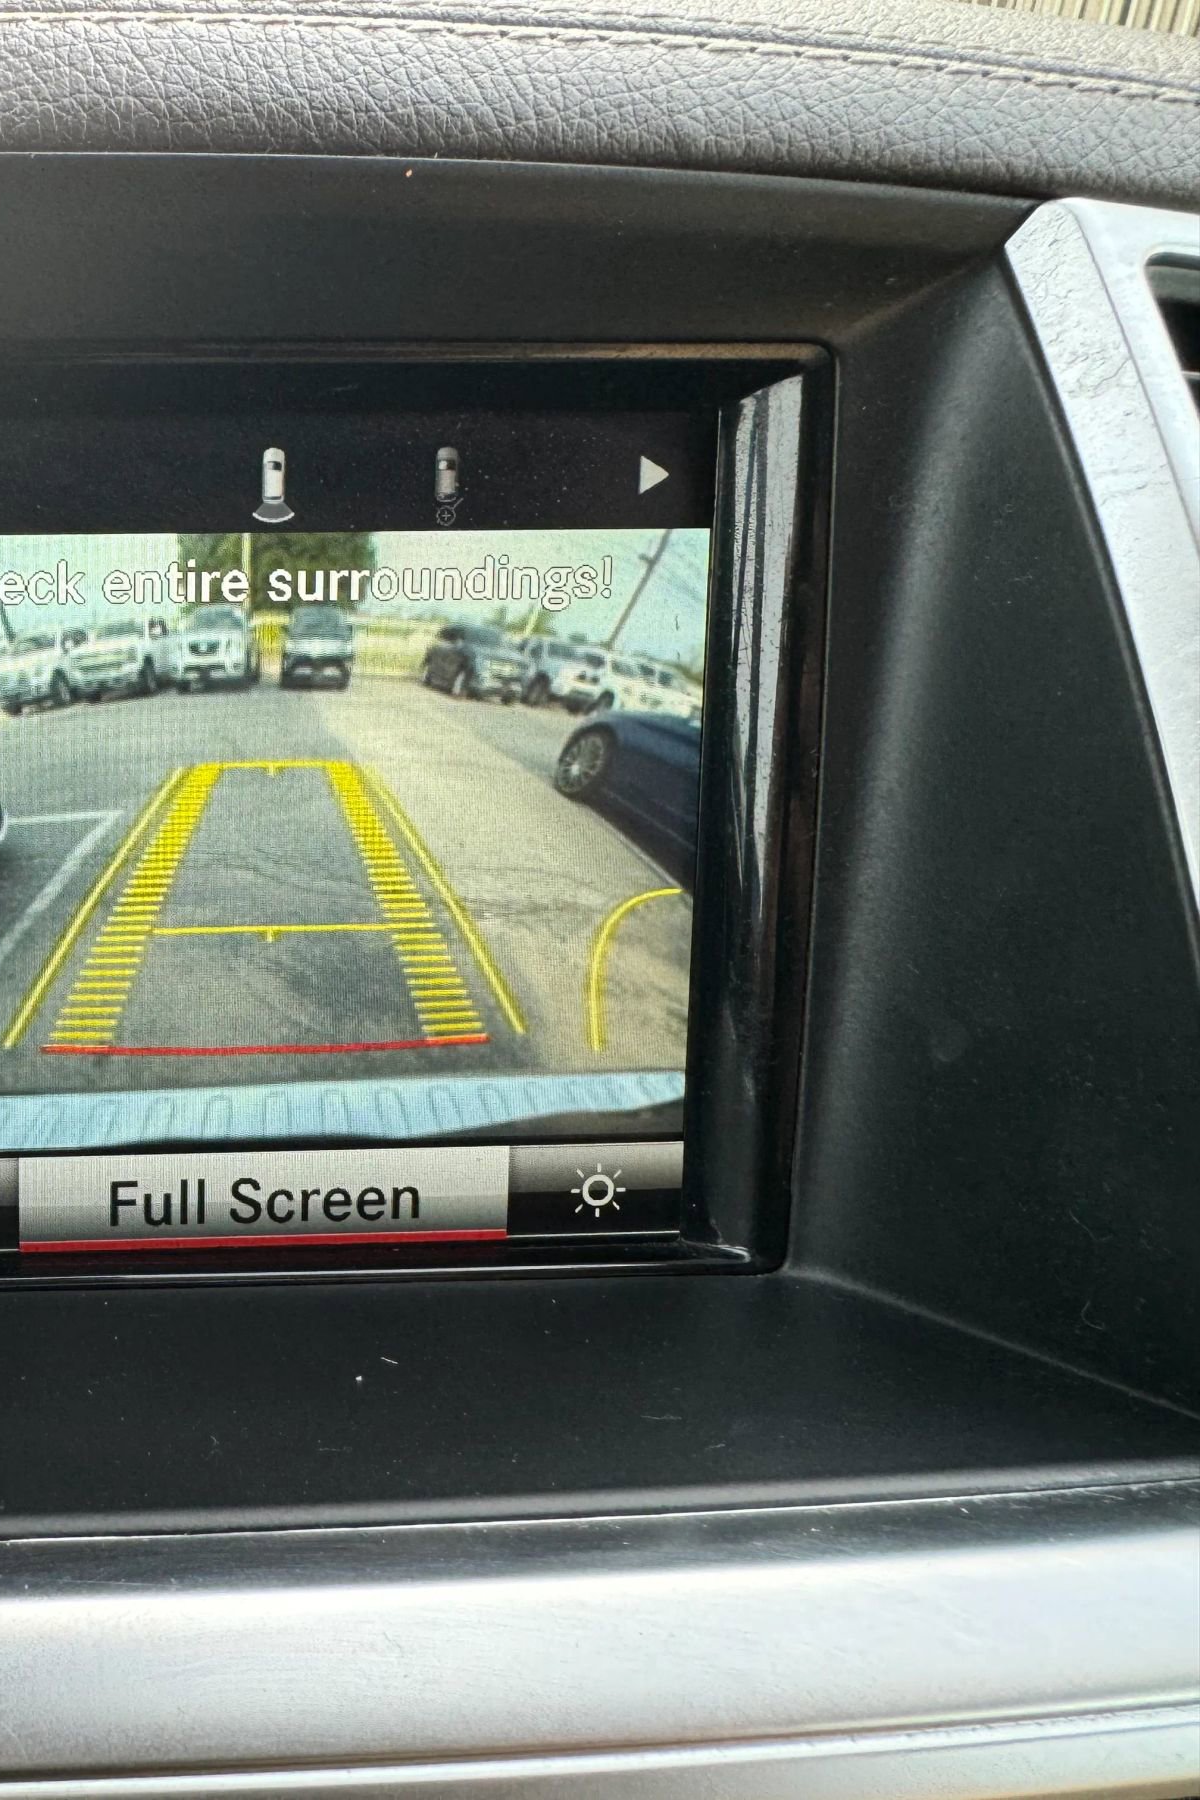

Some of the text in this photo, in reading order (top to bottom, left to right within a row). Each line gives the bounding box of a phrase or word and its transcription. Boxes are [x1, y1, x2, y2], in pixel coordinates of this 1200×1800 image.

[102, 558, 250, 604] entire
[267, 554, 613, 611] surroundings!
[110, 1177, 420, 1227] Full Screen
